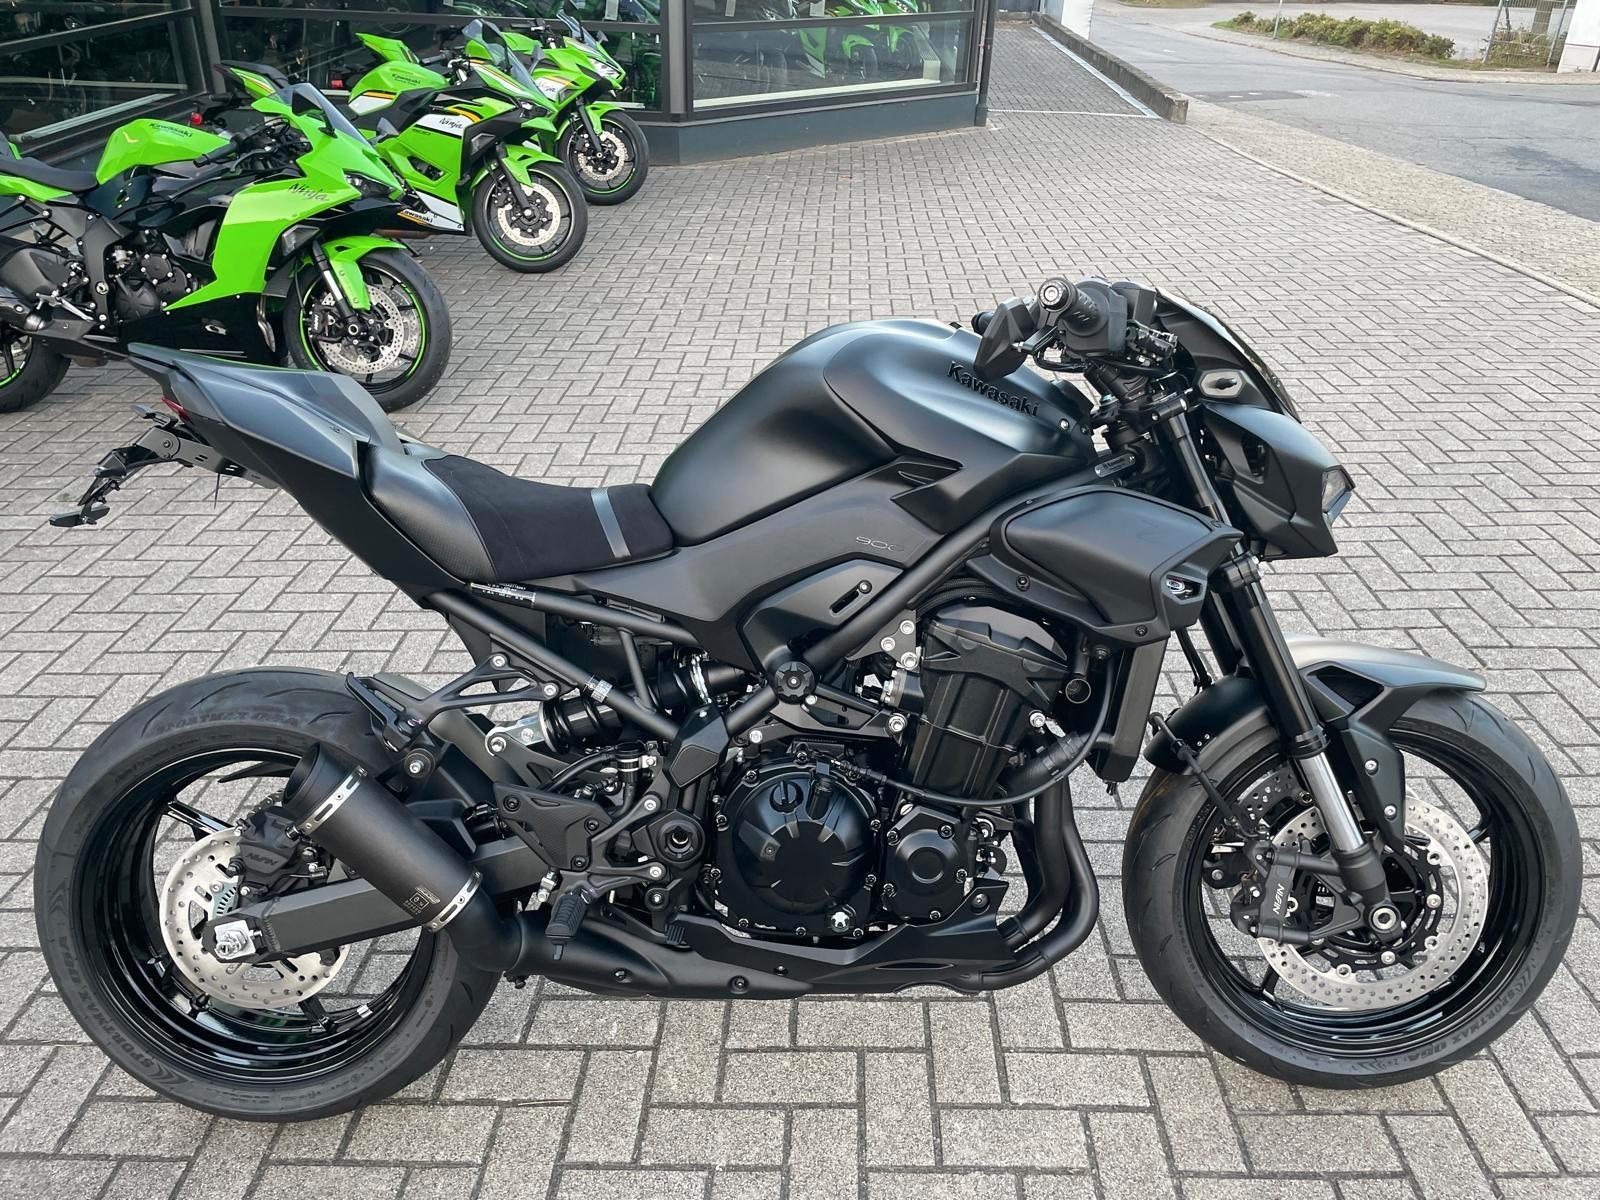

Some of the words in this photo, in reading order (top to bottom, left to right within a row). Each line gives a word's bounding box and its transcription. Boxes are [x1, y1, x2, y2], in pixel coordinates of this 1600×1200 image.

[149, 123, 193, 138] Kawasaki
[439, 117, 464, 130] Ninja
[289, 183, 329, 201] Ninja
[402, 209, 433, 223] awasaki
[947, 361, 1041, 417] Kawasaki
[855, 536, 905, 552] 900
[1272, 883, 1285, 915] NISSIN
[1451, 989, 1515, 1044] SPORTMAX
[78, 988, 155, 1067] SPORTMAX
